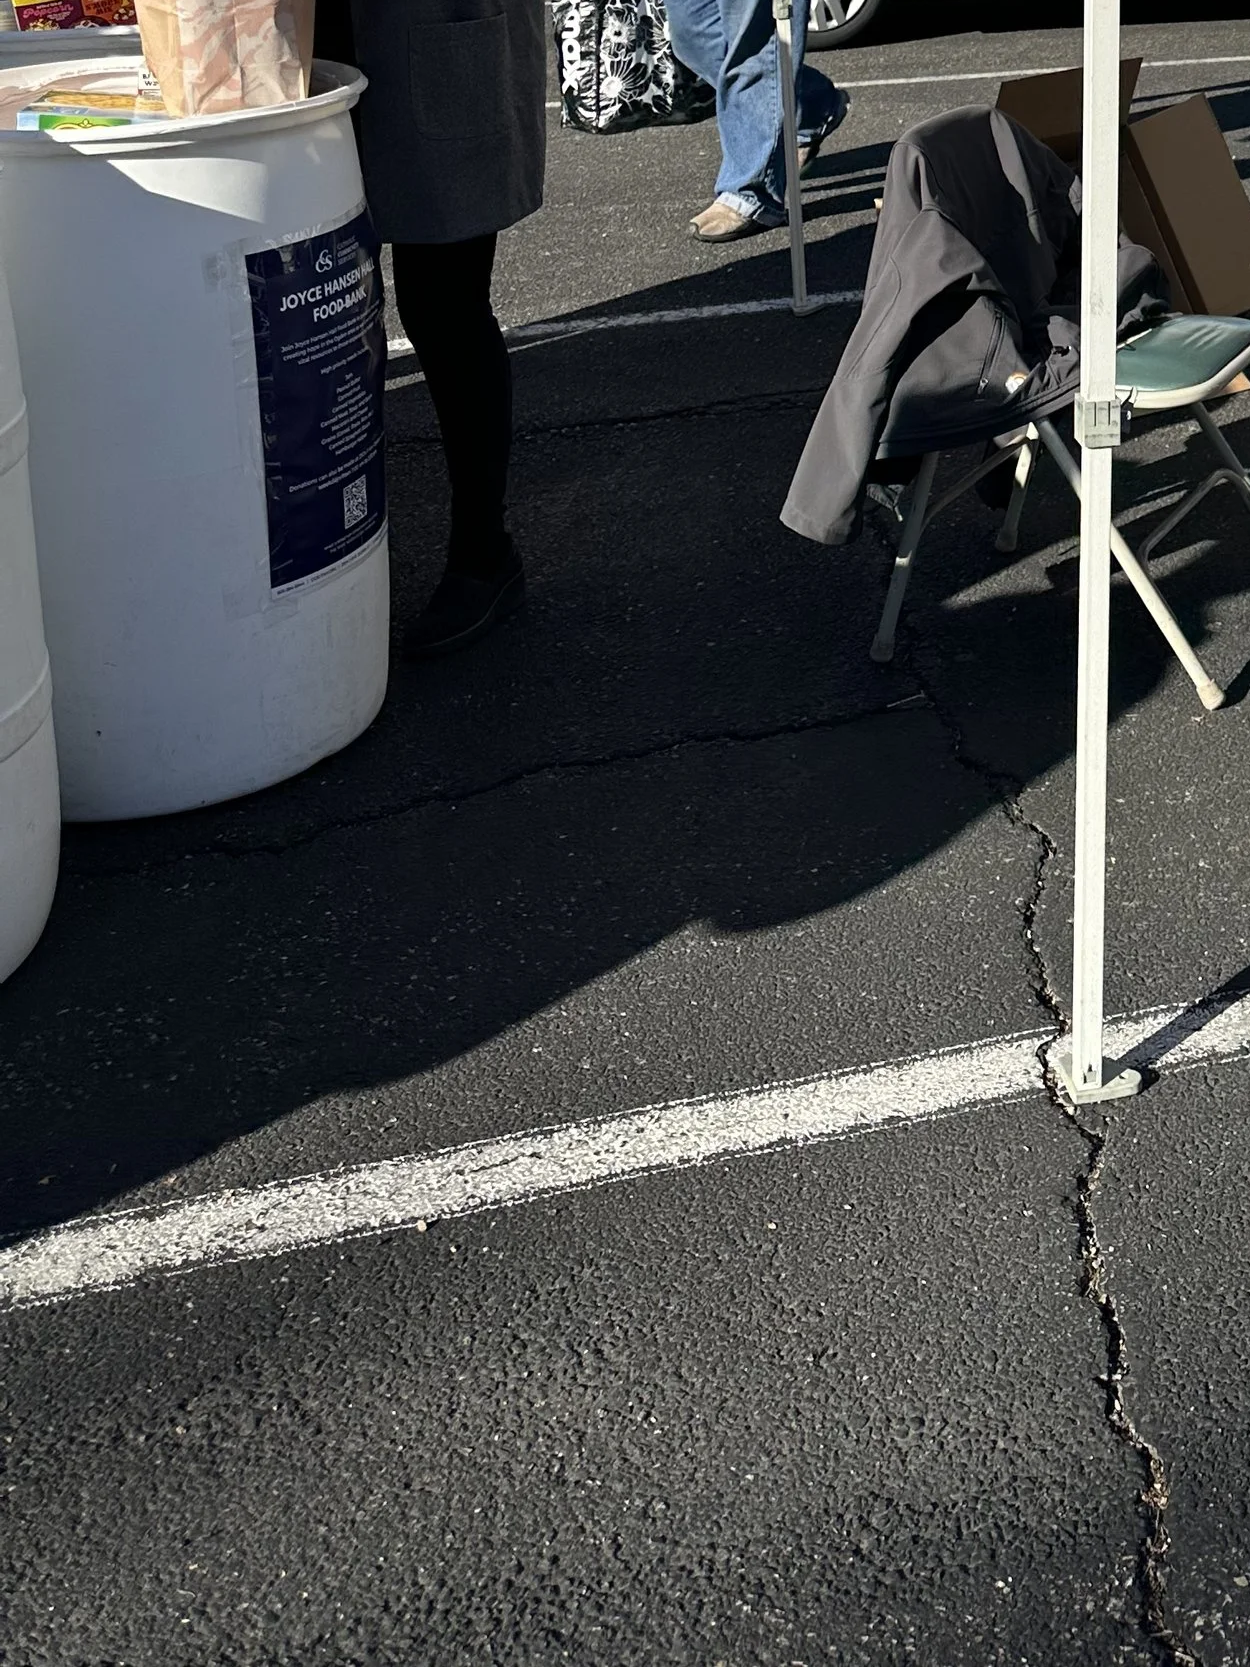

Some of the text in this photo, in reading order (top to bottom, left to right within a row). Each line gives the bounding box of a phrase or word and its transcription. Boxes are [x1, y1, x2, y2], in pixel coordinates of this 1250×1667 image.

[22, 4, 74, 19] Popcorn
[280, 256, 375, 312] JOYCE HANSEN HALL
[313, 298, 343, 322] FOOD
